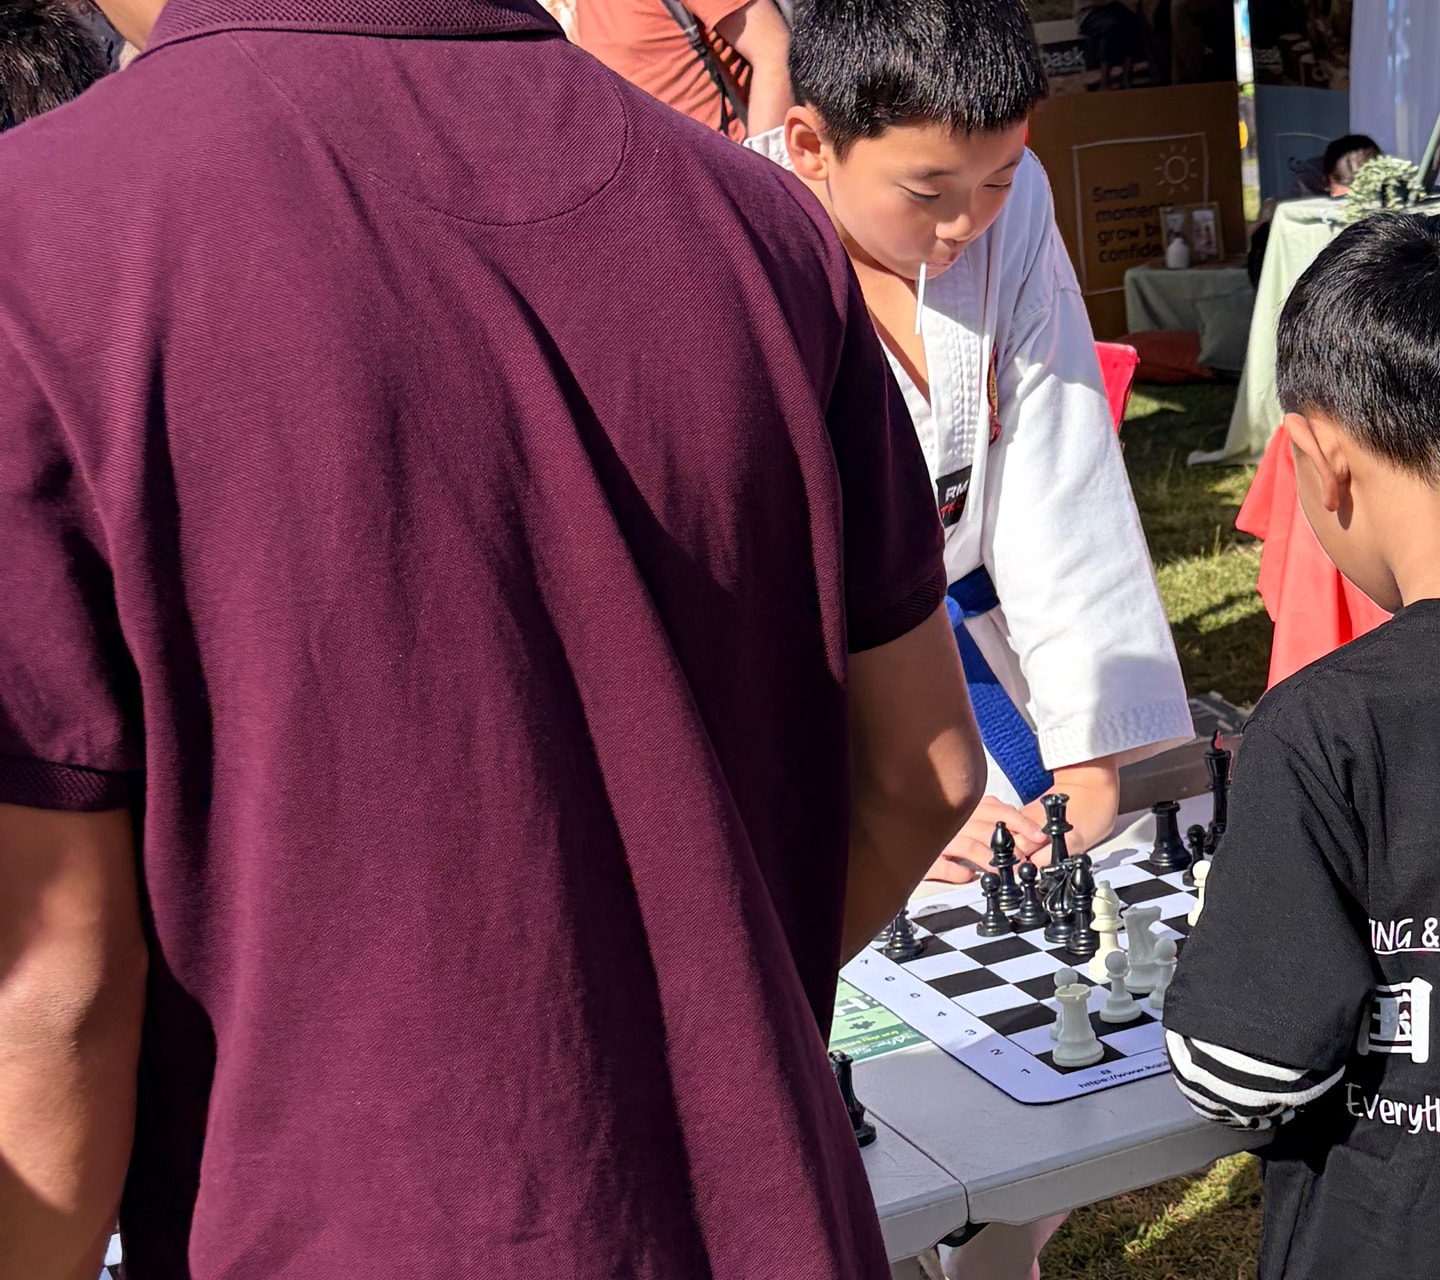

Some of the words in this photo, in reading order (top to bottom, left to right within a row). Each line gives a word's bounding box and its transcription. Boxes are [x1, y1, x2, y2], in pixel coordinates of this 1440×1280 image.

[1092, 182, 1140, 203] Small
[1096, 227, 1140, 248] grow
[1369, 917, 1414, 951] ING
[1421, 916, 1440, 948] &
